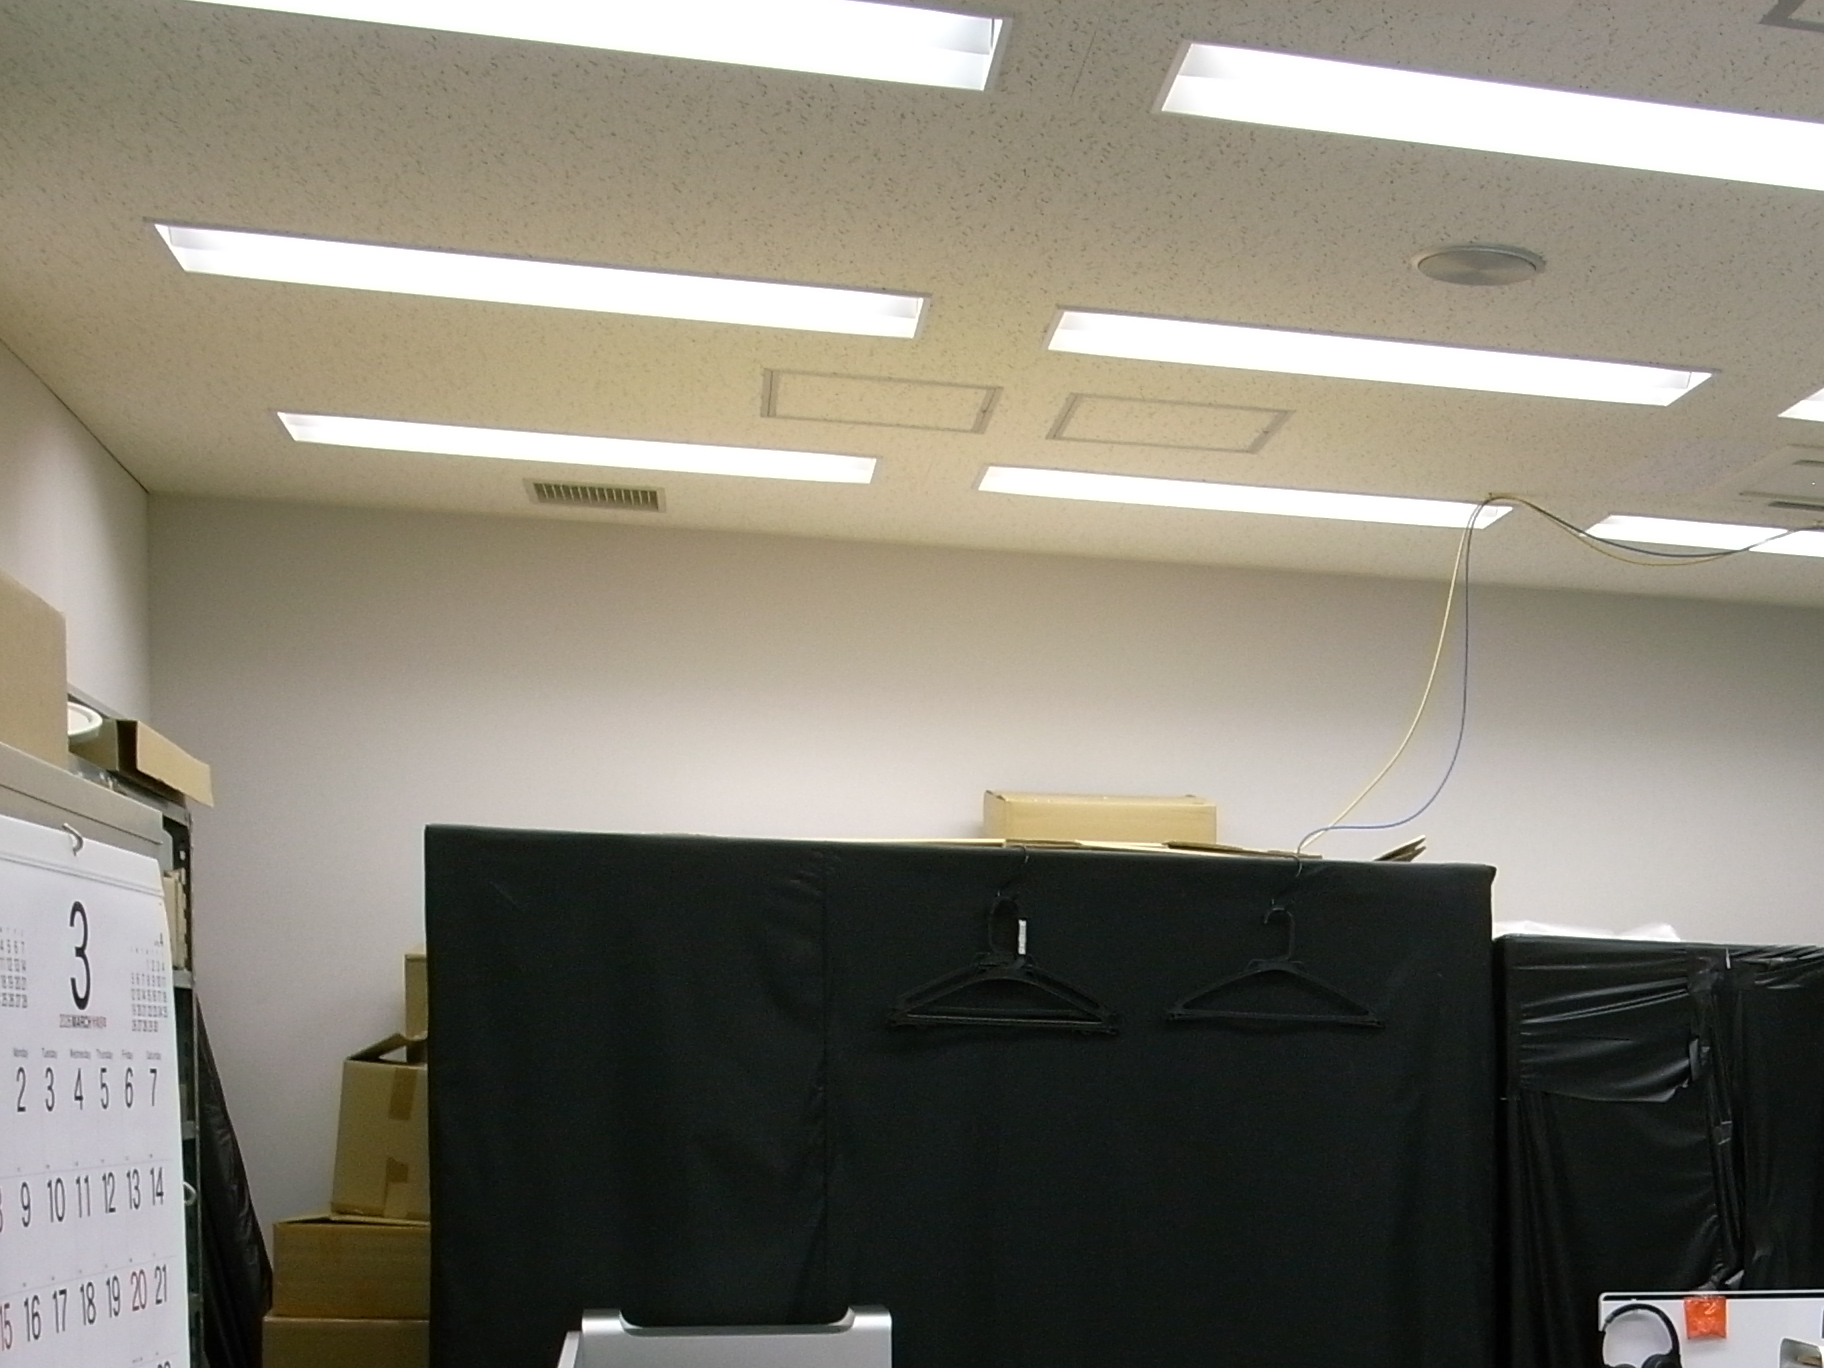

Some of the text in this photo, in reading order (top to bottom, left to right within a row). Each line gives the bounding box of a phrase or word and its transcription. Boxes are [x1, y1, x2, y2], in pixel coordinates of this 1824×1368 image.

[69, 900, 91, 1011] 3
[16, 1066, 157, 1113] 2 3 4 5 6 7
[20, 1181, 31, 1228] 9
[47, 1177, 66, 1223] 10
[75, 1174, 91, 1219] 11
[102, 1171, 117, 1214] 12
[126, 1168, 141, 1210] 13
[150, 1166, 164, 1206] 14
[23, 1294, 42, 1343] 16
[52, 1288, 68, 1334] 17
[80, 1281, 97, 1326] 18
[105, 1275, 121, 1319] 19
[130, 1268, 148, 1312] 20
[154, 1263, 168, 1305] 21
